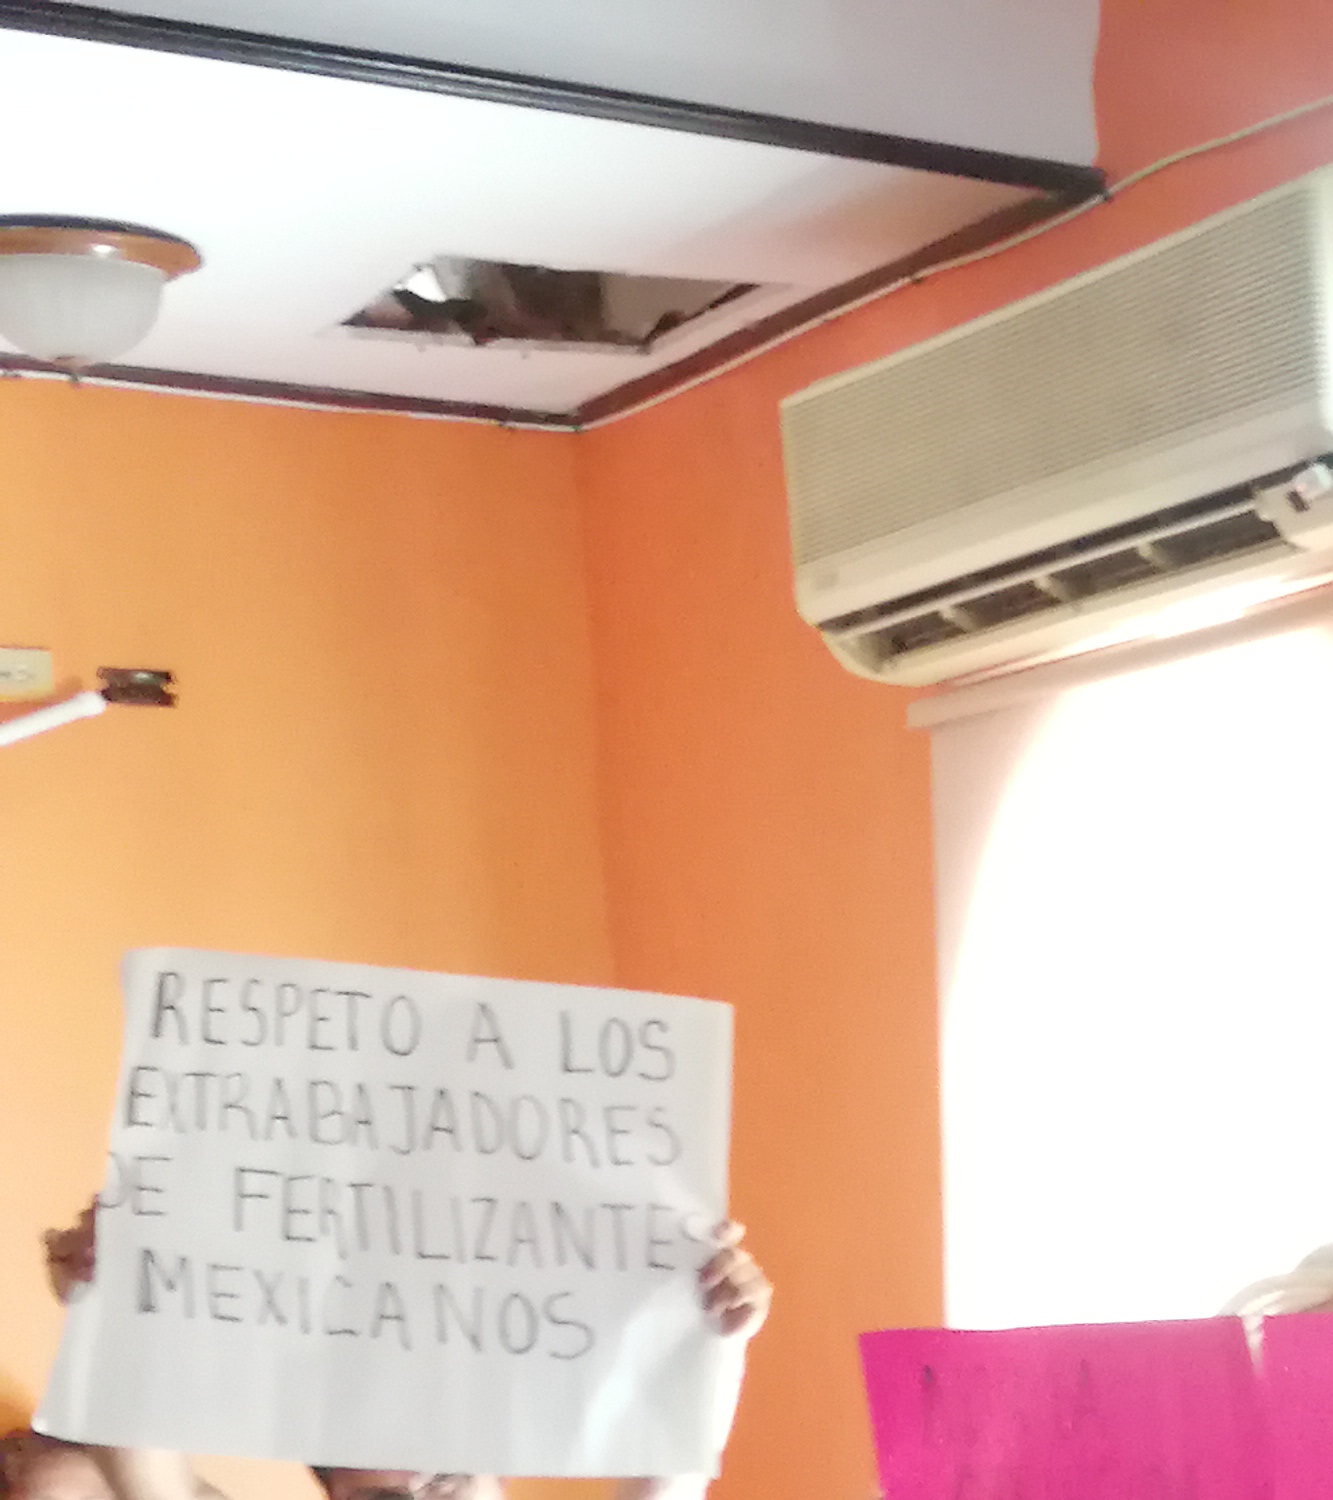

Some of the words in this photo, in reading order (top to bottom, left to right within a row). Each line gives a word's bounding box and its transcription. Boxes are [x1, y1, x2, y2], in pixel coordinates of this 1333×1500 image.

[150, 970, 424, 1057] RESPETO
[465, 1002, 515, 1070] A
[558, 1010, 679, 1082] LOS
[122, 1064, 684, 1168] EXTRABAJADORES
[134, 1246, 596, 1361] MEXICANOS
